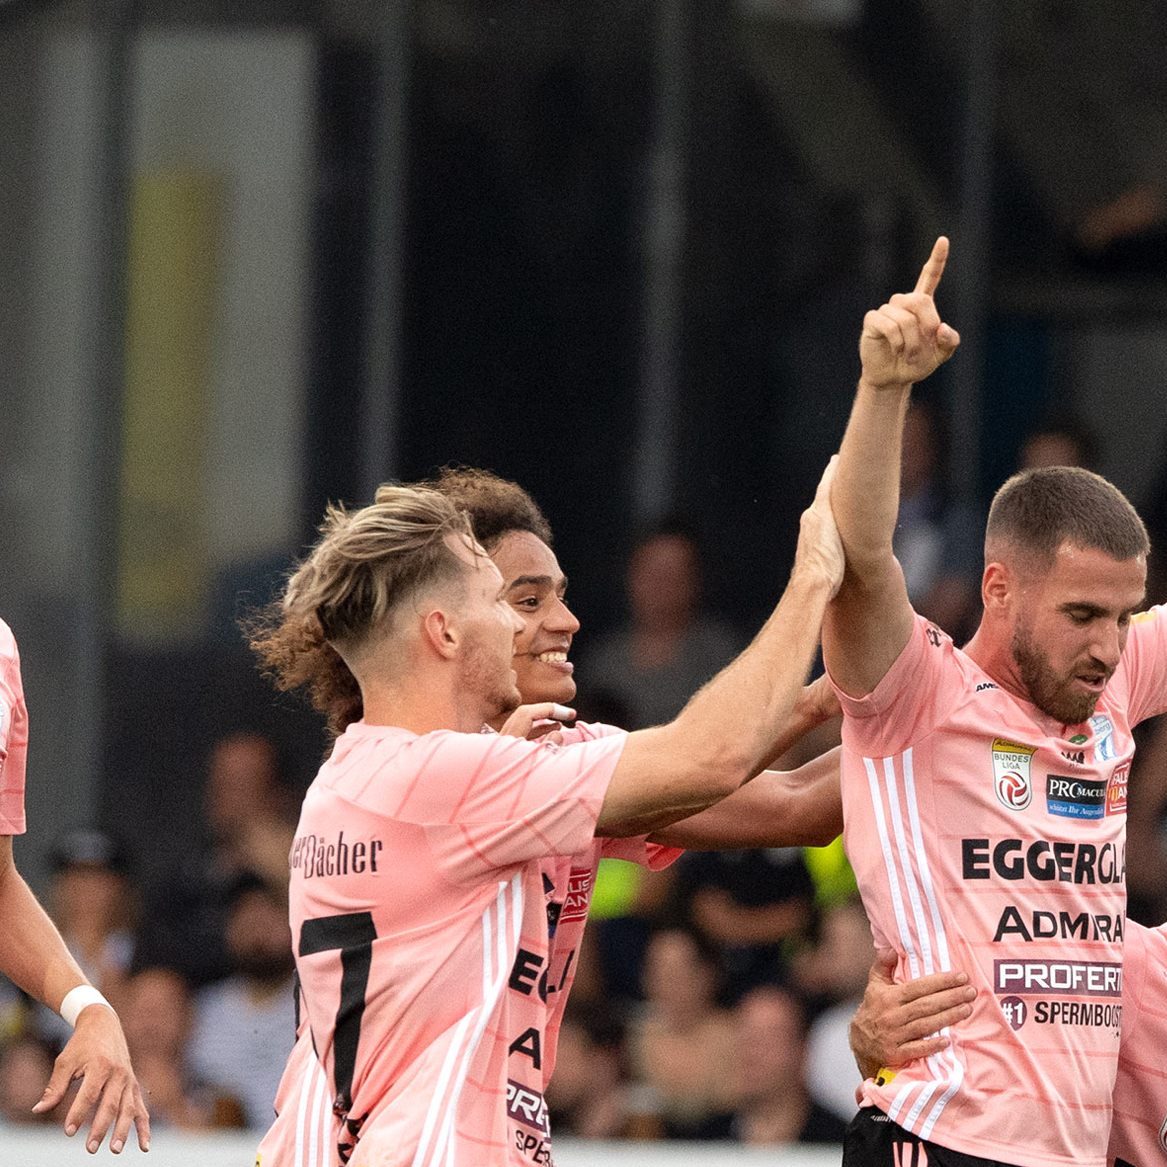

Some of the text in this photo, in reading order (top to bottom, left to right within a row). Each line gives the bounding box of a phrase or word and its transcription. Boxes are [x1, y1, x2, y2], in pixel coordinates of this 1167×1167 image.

[994, 753, 1029, 763] BUNDES
[1002, 762, 1021, 770] LIGA
[993, 906, 1124, 943] ADMIRA
[297, 911, 378, 1113] 7
